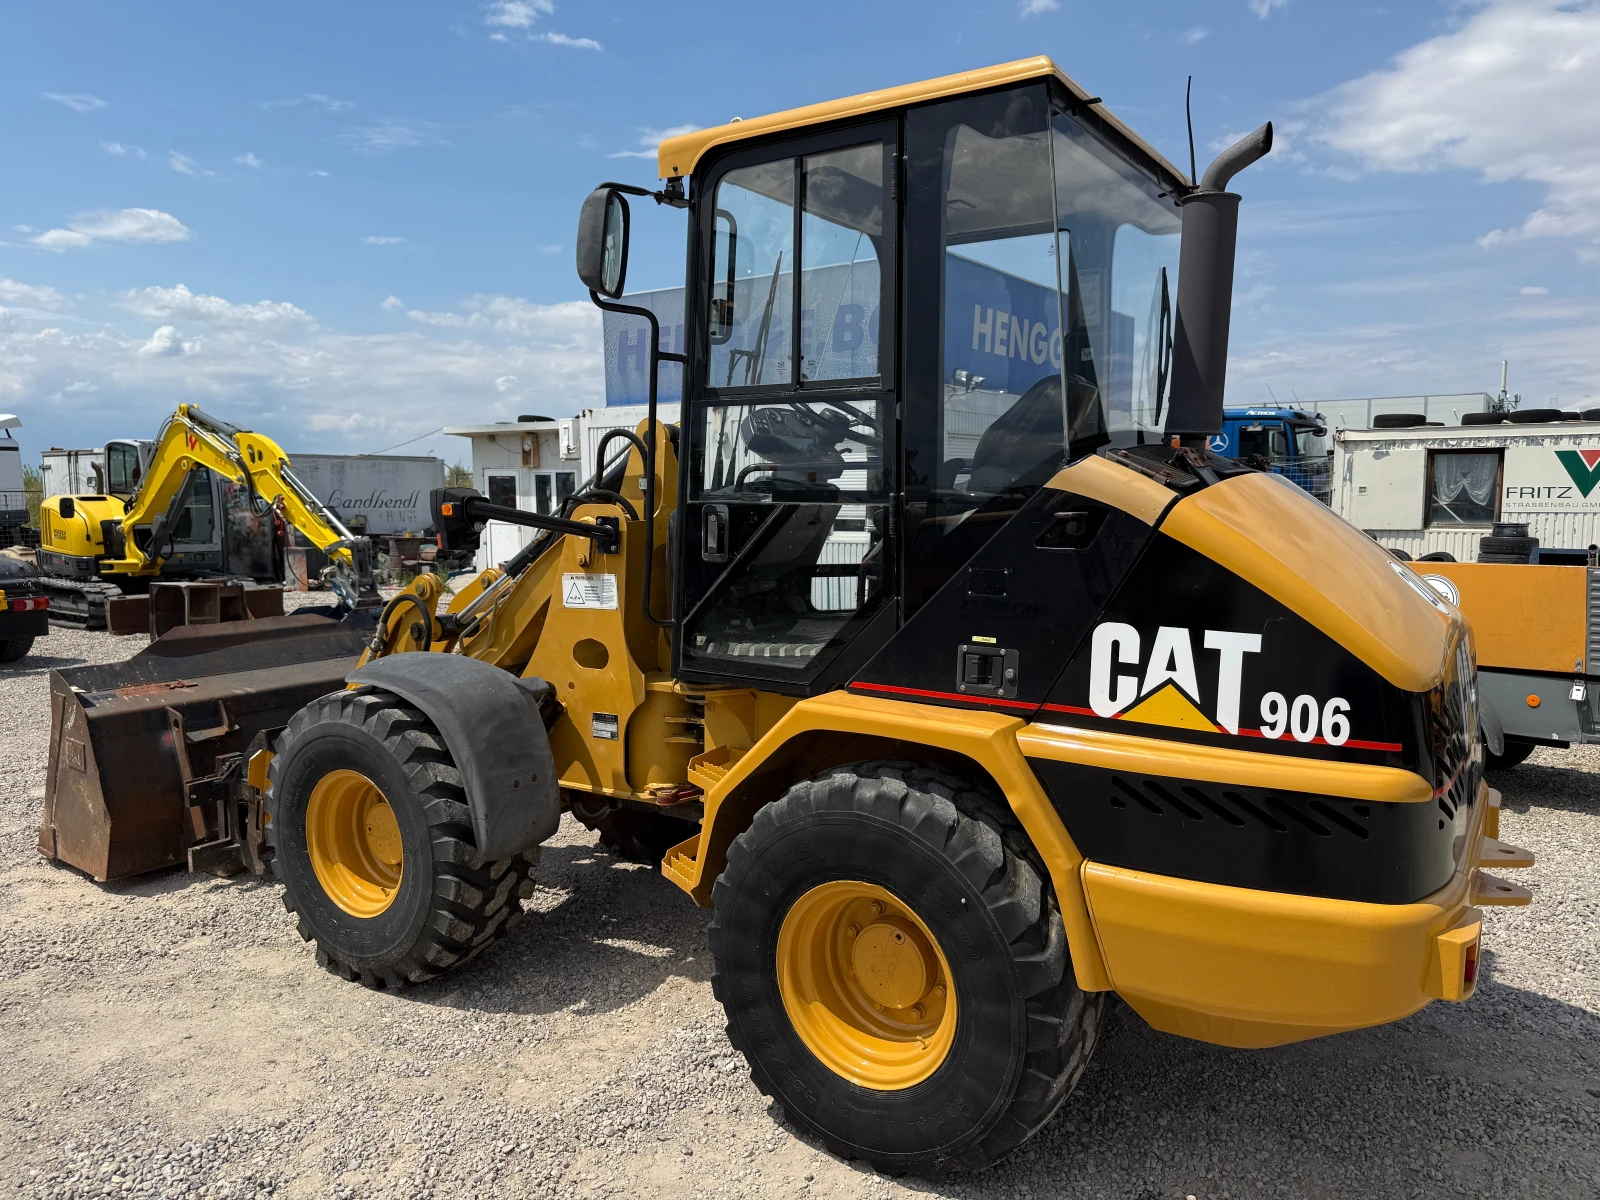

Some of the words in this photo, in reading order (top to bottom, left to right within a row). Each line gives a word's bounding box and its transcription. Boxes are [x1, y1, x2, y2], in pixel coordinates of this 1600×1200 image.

[325, 488, 422, 509] Landhendl
[1505, 486, 1573, 499] FRITZ
[1088, 621, 1262, 735] CAT
[1259, 691, 1351, 746] 906
